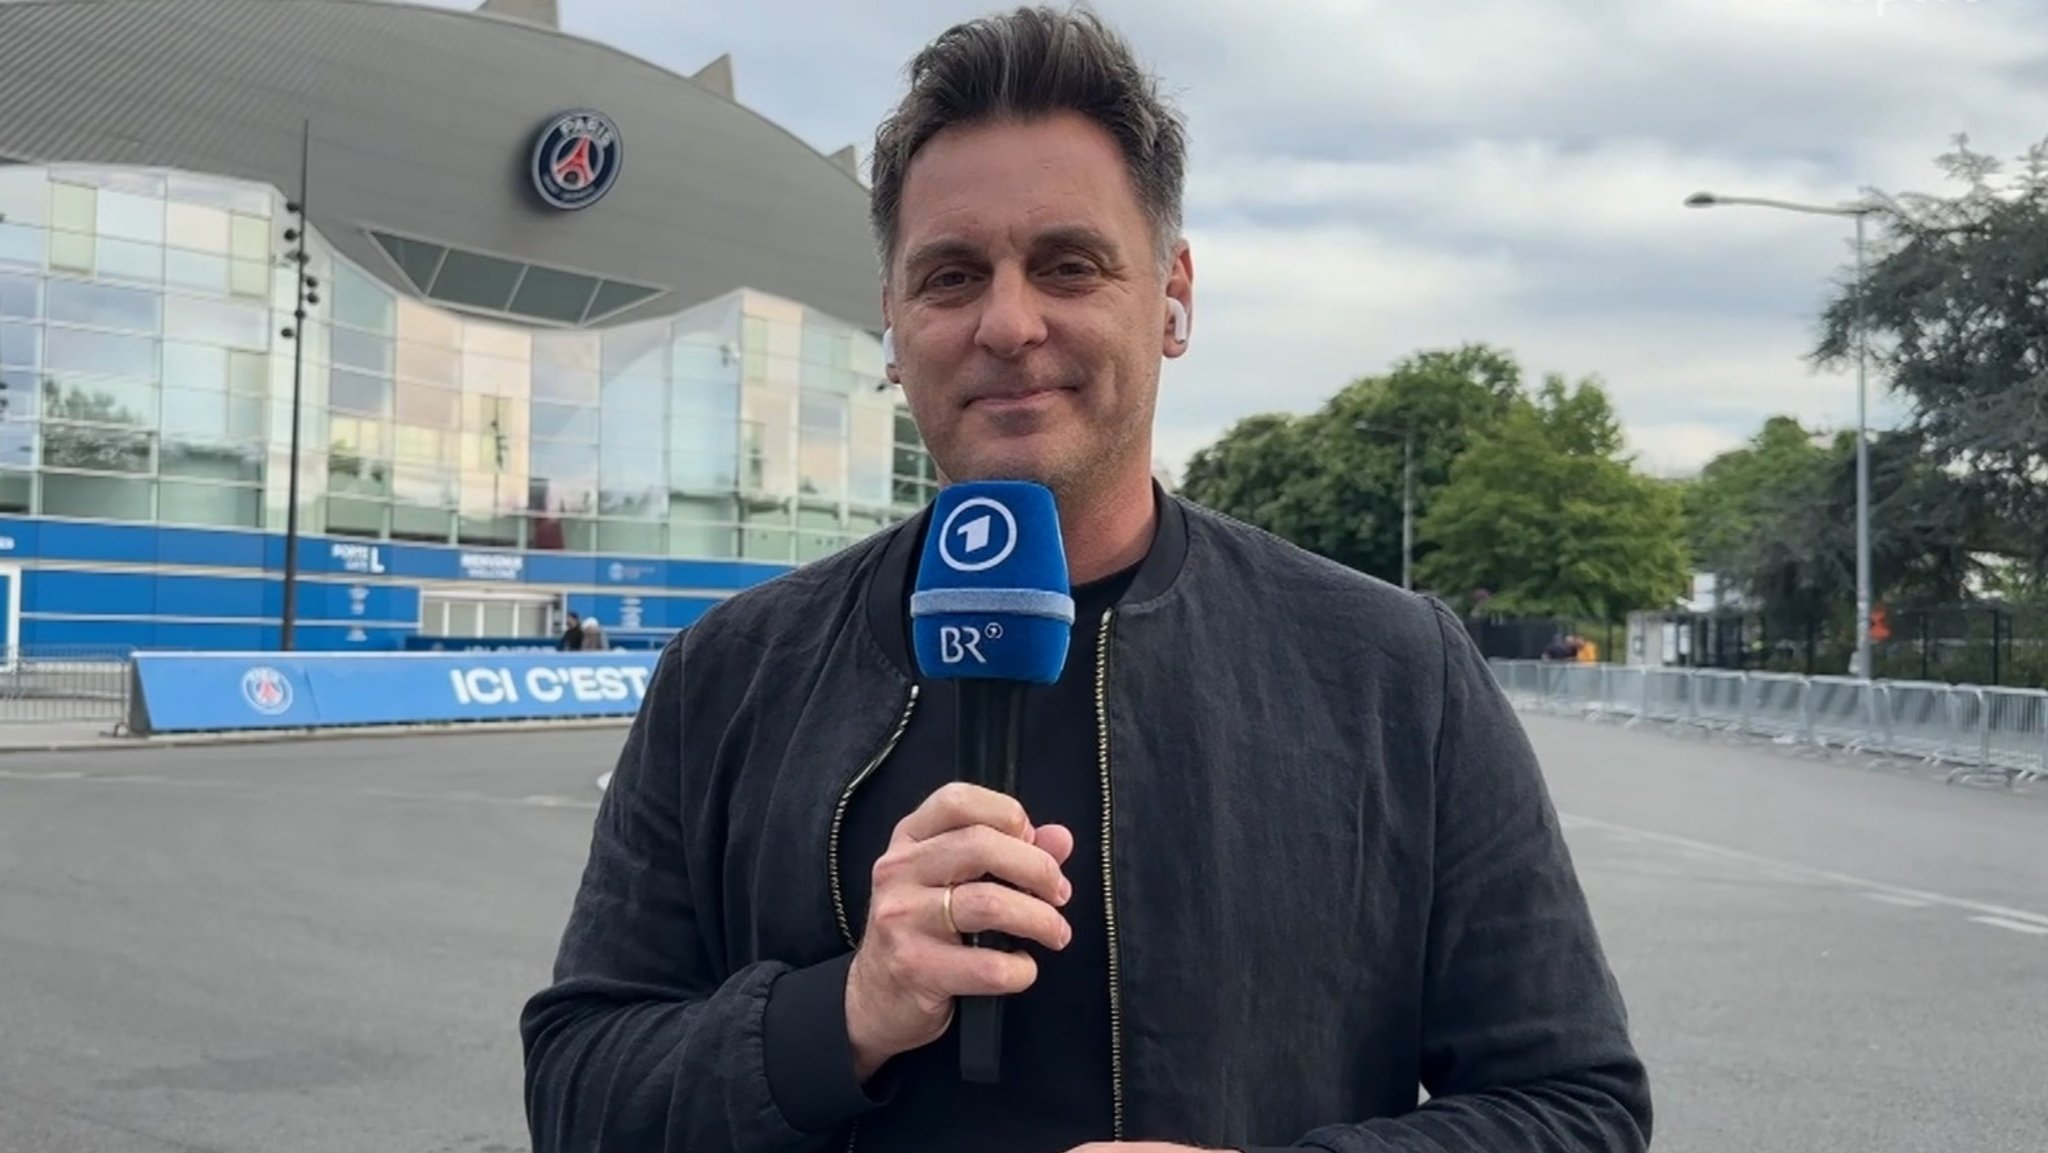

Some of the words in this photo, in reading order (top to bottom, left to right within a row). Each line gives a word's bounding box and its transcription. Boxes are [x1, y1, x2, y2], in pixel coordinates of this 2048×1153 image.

[559, 116, 612, 146] PARIS
[370, 546, 385, 573] L
[940, 626, 987, 664] BR
[450, 667, 519, 705] ICI
[525, 666, 648, 703] C'EST
